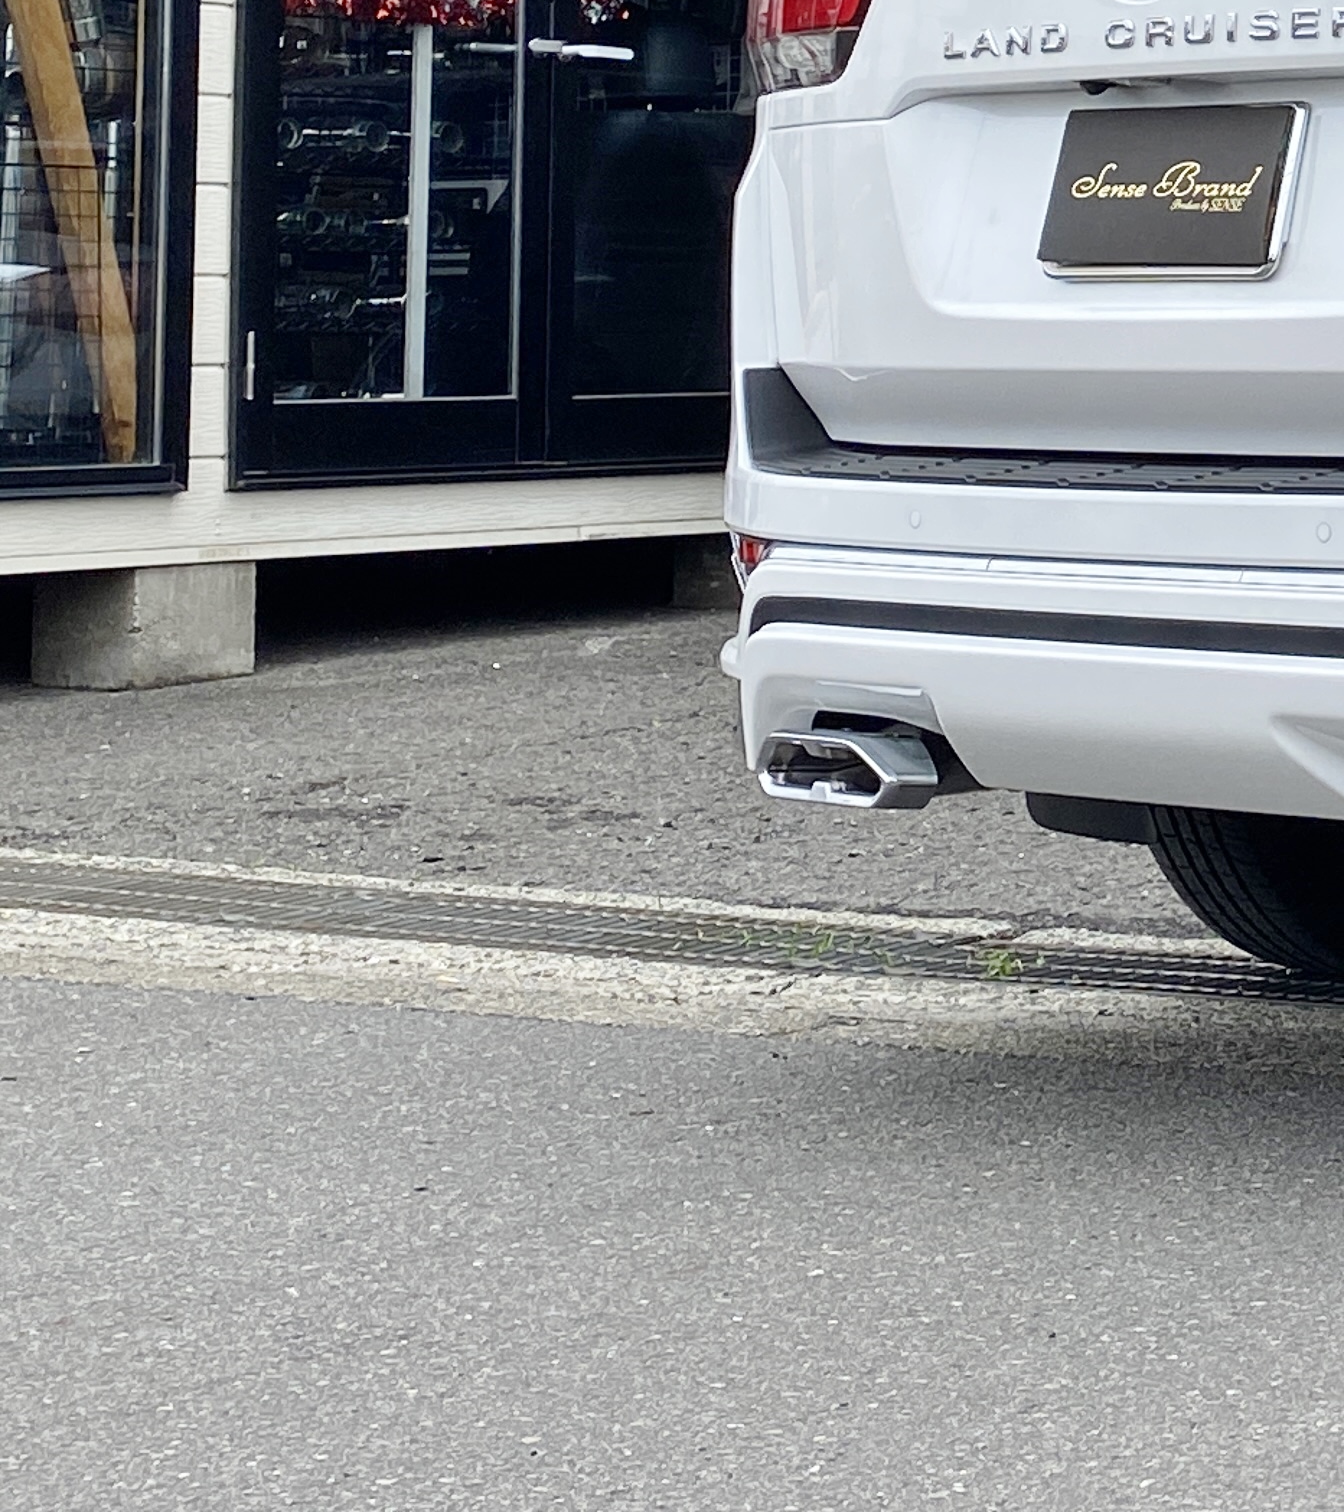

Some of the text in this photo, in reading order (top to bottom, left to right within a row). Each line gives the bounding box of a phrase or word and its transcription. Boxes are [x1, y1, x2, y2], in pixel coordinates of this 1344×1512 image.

[943, 22, 1069, 60] LAND
[1071, 159, 1265, 198] Sense Brand
